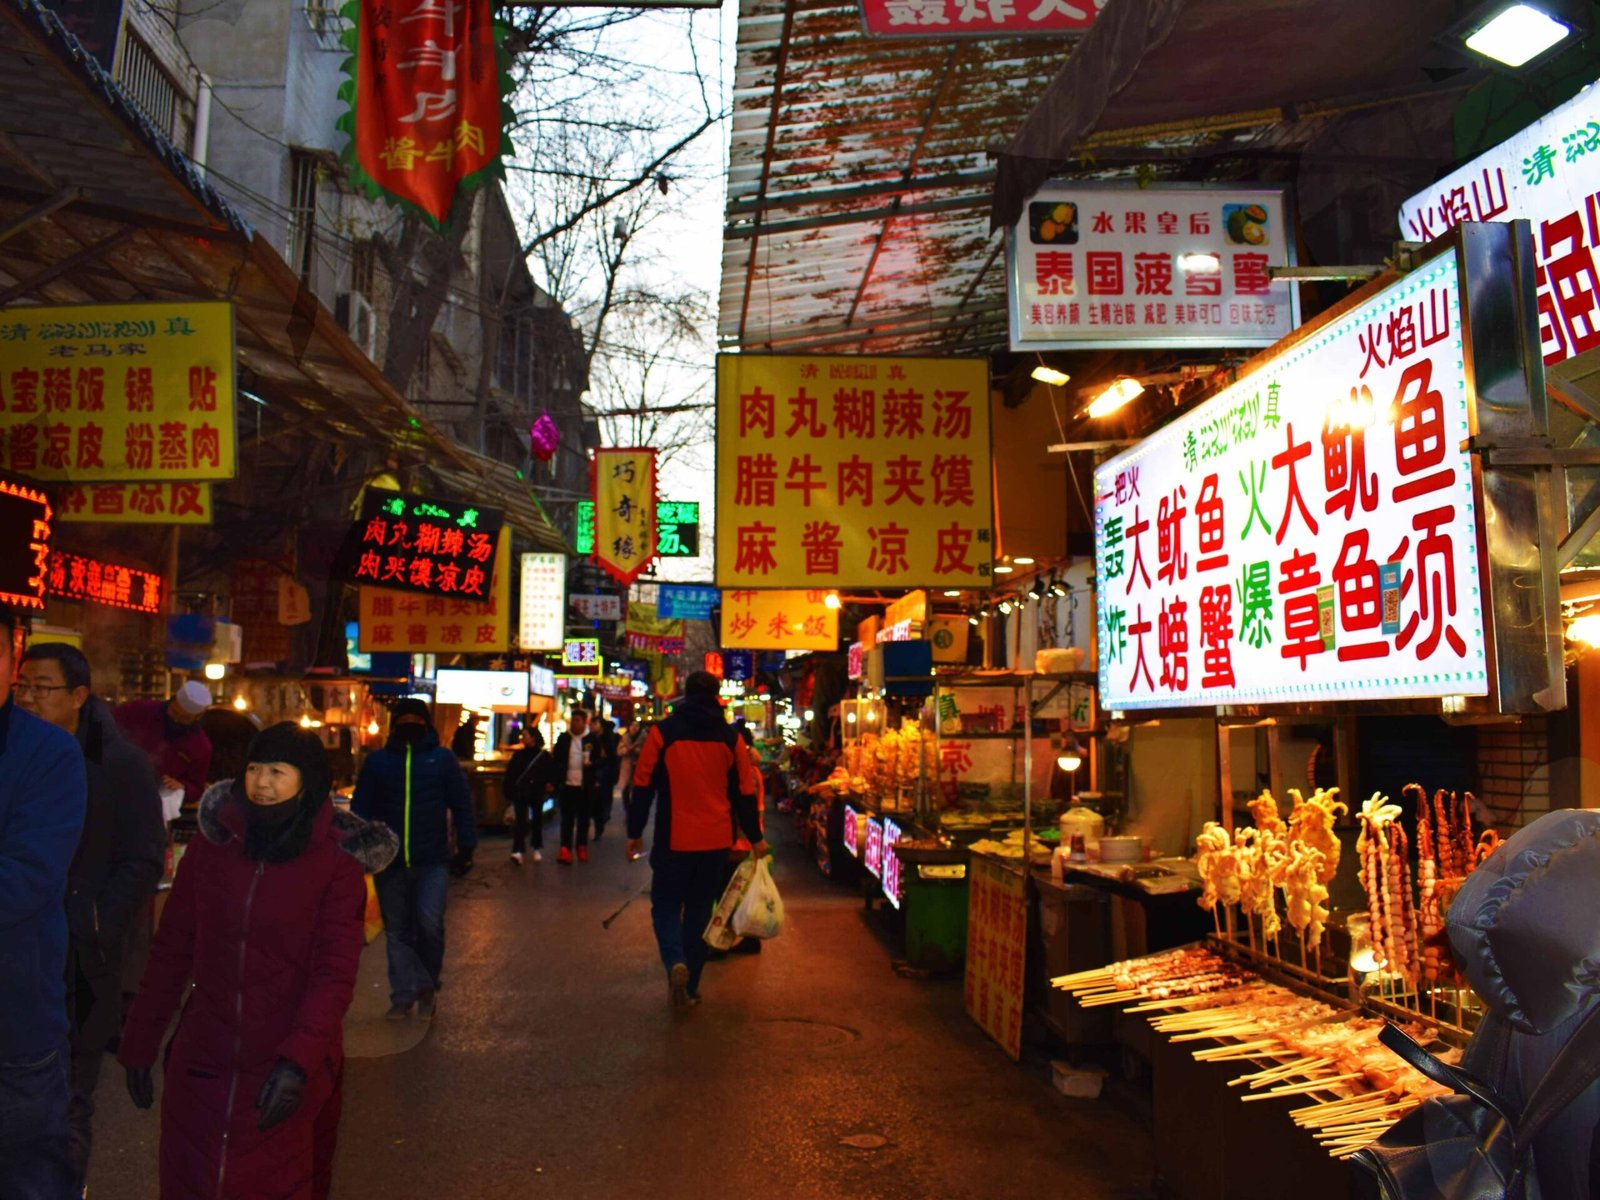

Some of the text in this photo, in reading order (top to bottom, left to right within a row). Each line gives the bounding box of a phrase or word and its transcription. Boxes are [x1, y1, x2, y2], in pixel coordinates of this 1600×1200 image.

[1091, 211, 1211, 235] 水果皇后
[163, 316, 197, 336] 真
[1144, 303, 1168, 325] 减肥
[1175, 303, 1223, 325] 美味可口
[1358, 288, 1451, 379] 火焰山
[738, 385, 973, 440] 肉丸糊辣汤
[125, 420, 220, 470] 粉蒸肉
[1271, 357, 1457, 547] 大鱿鱼
[733, 453, 975, 508] 腊牛肉夹馍
[1102, 466, 1141, 507] 一把火
[733, 520, 976, 576] 麻酱凉皮
[1125, 473, 1230, 596] 大鱿鱼
[1278, 504, 1468, 672] 章鱼须
[372, 623, 498, 646] 麻酱凉皮
[729, 611, 834, 640] 炒米饭
[1128, 583, 1236, 694] 大螃蟹
